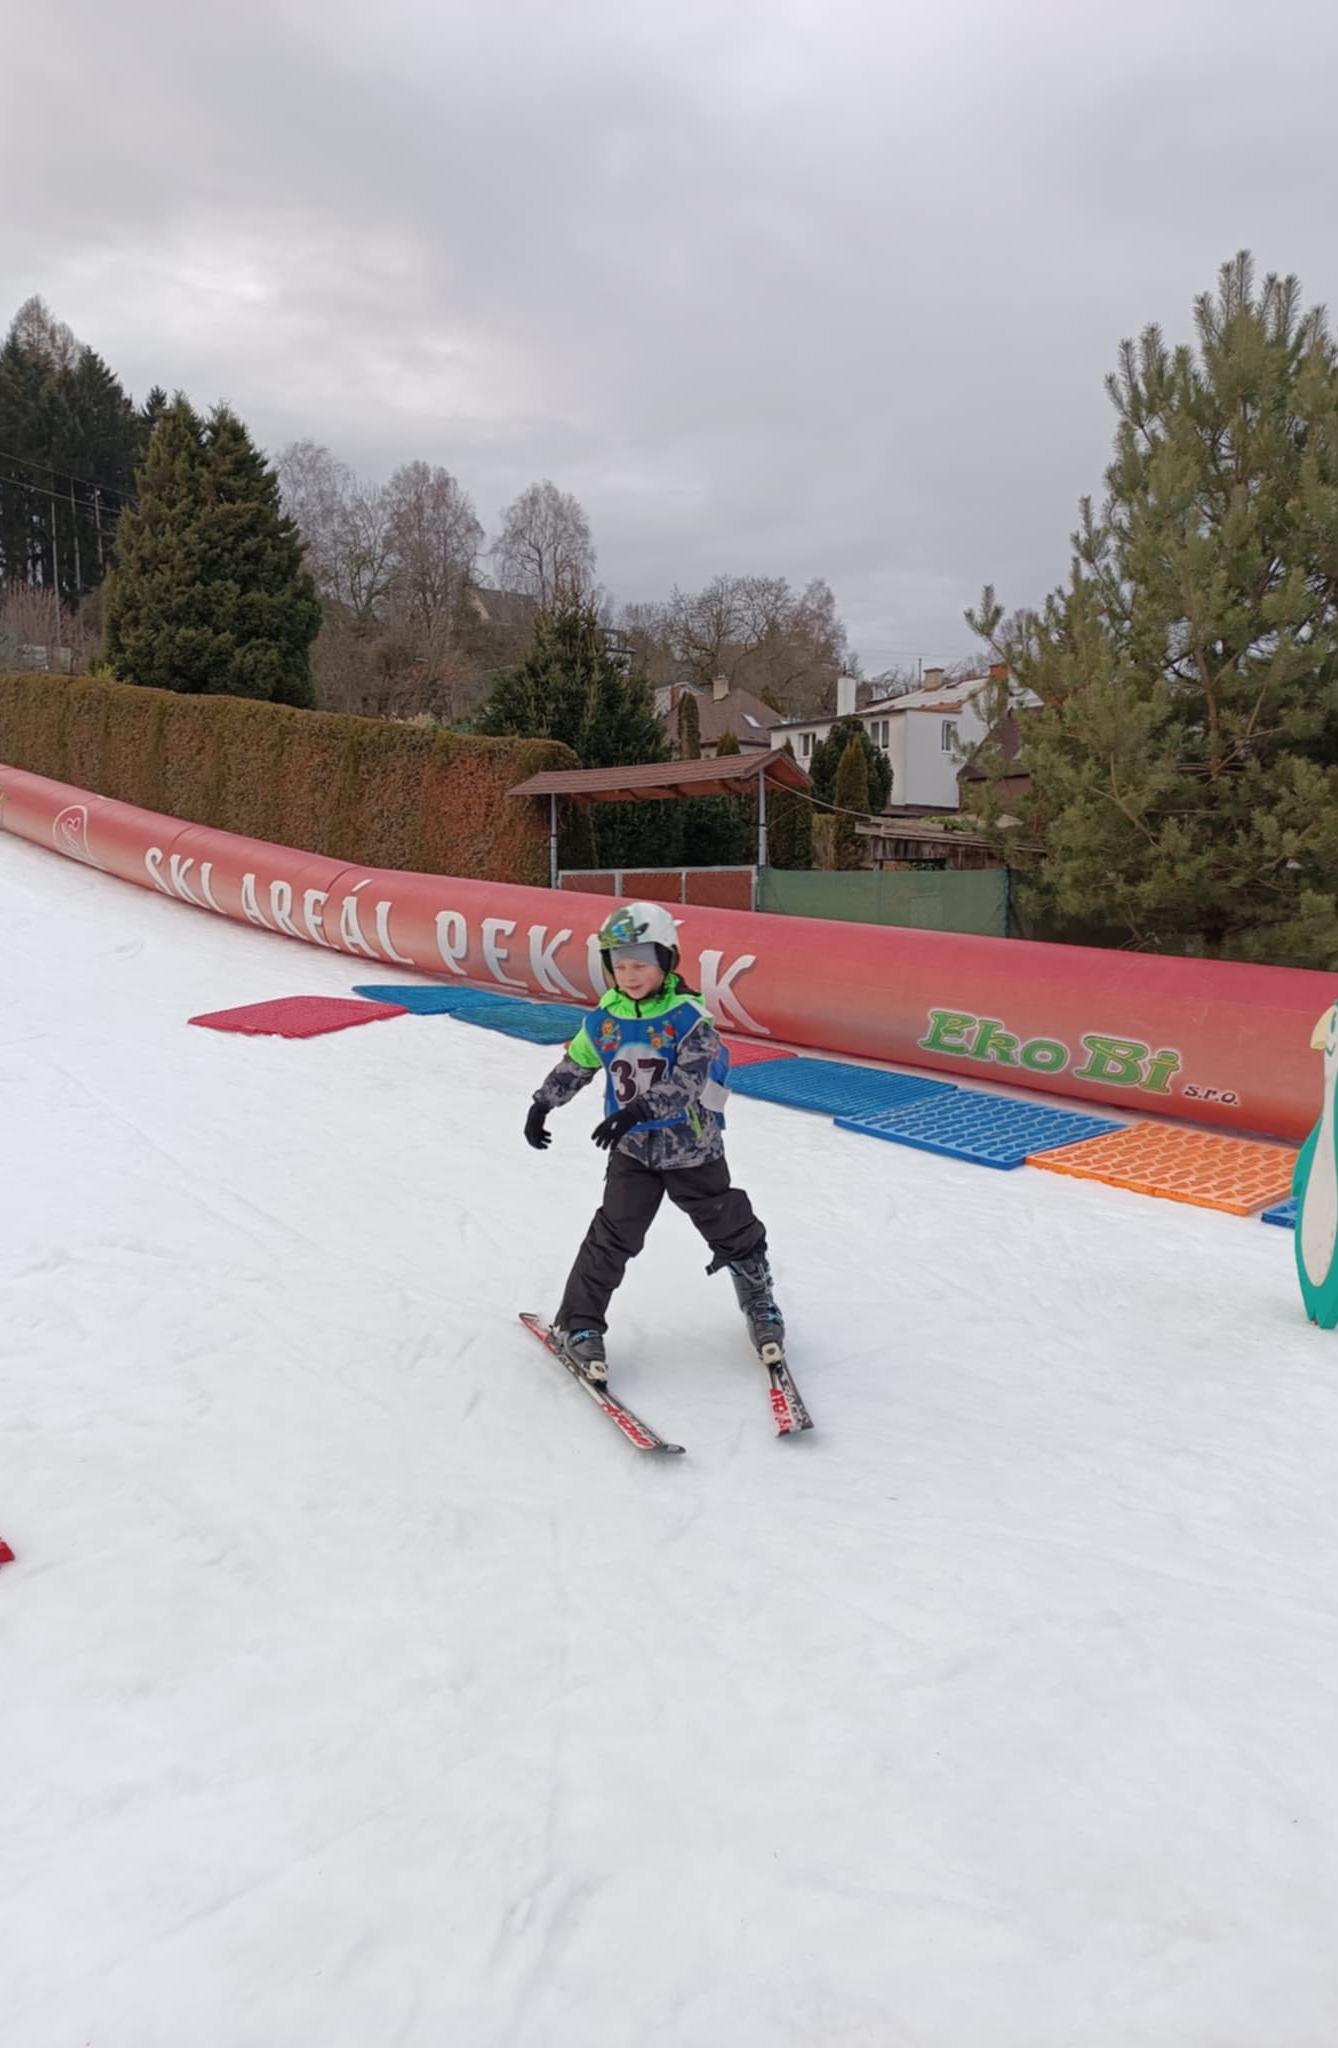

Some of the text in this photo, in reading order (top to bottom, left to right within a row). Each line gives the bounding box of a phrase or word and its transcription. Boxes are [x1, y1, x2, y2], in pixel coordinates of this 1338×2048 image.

[144, 846, 228, 914] SKI
[241, 873, 415, 964] AREÁL
[610, 1057, 668, 1104] 37
[917, 1008, 1239, 1106] Eko Bi s.r.o.
